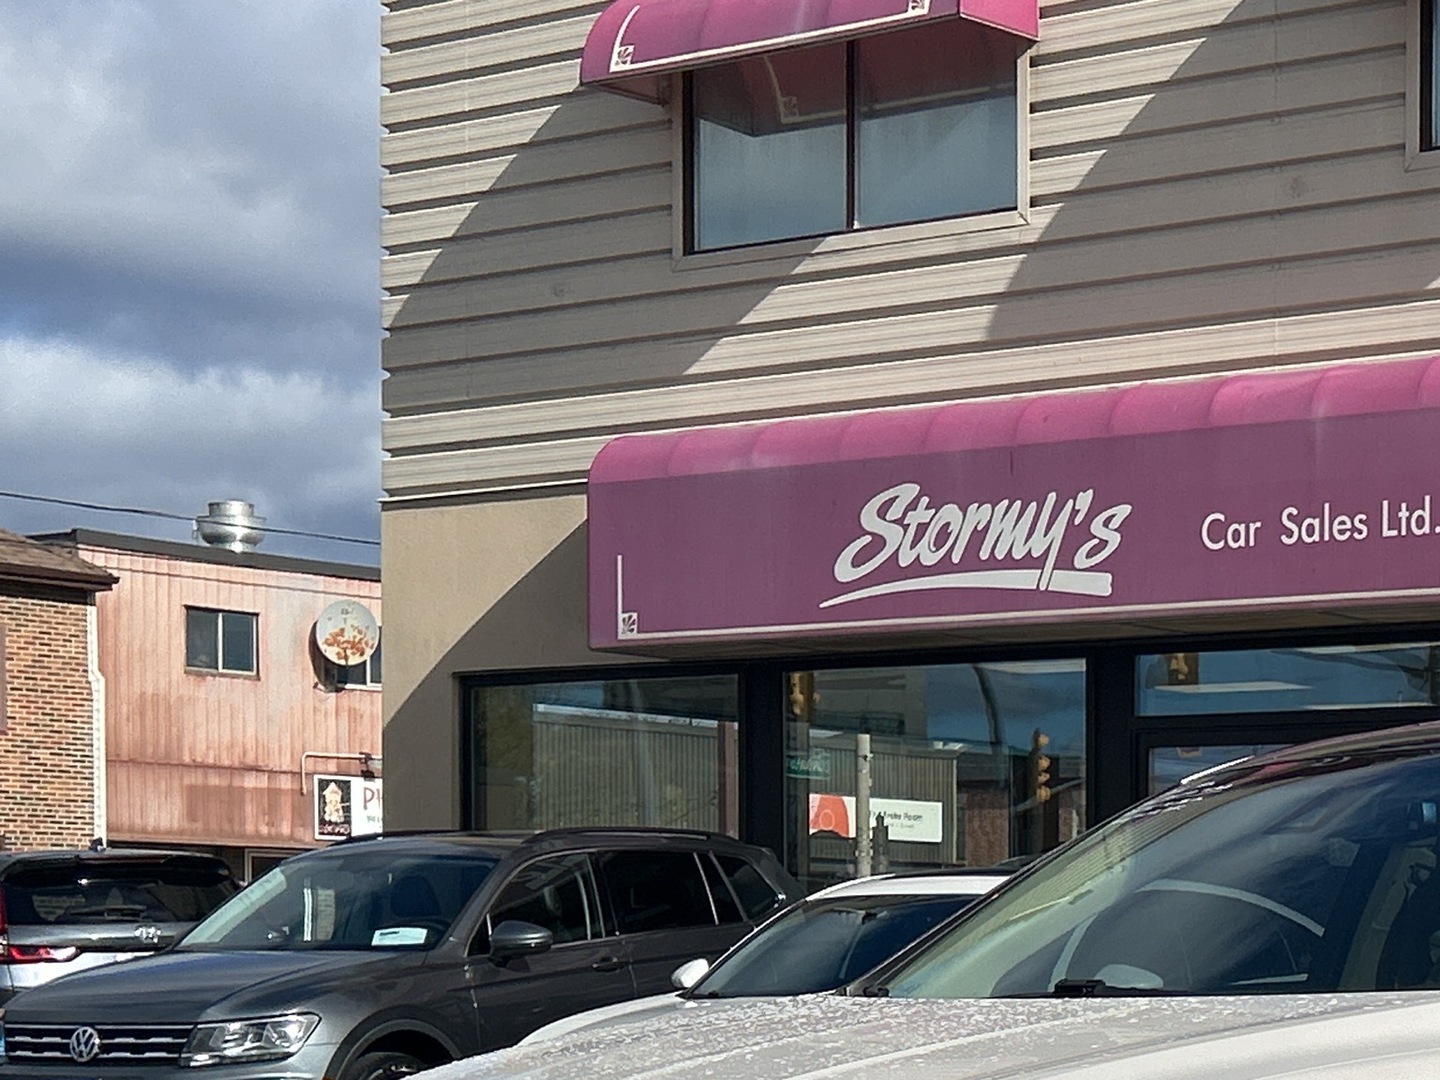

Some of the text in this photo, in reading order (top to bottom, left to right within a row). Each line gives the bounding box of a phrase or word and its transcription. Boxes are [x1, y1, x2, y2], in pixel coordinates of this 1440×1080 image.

[834, 483, 1132, 591] Stormy's
[1200, 512, 1262, 550] Car
[1280, 502, 1369, 546] Sales
